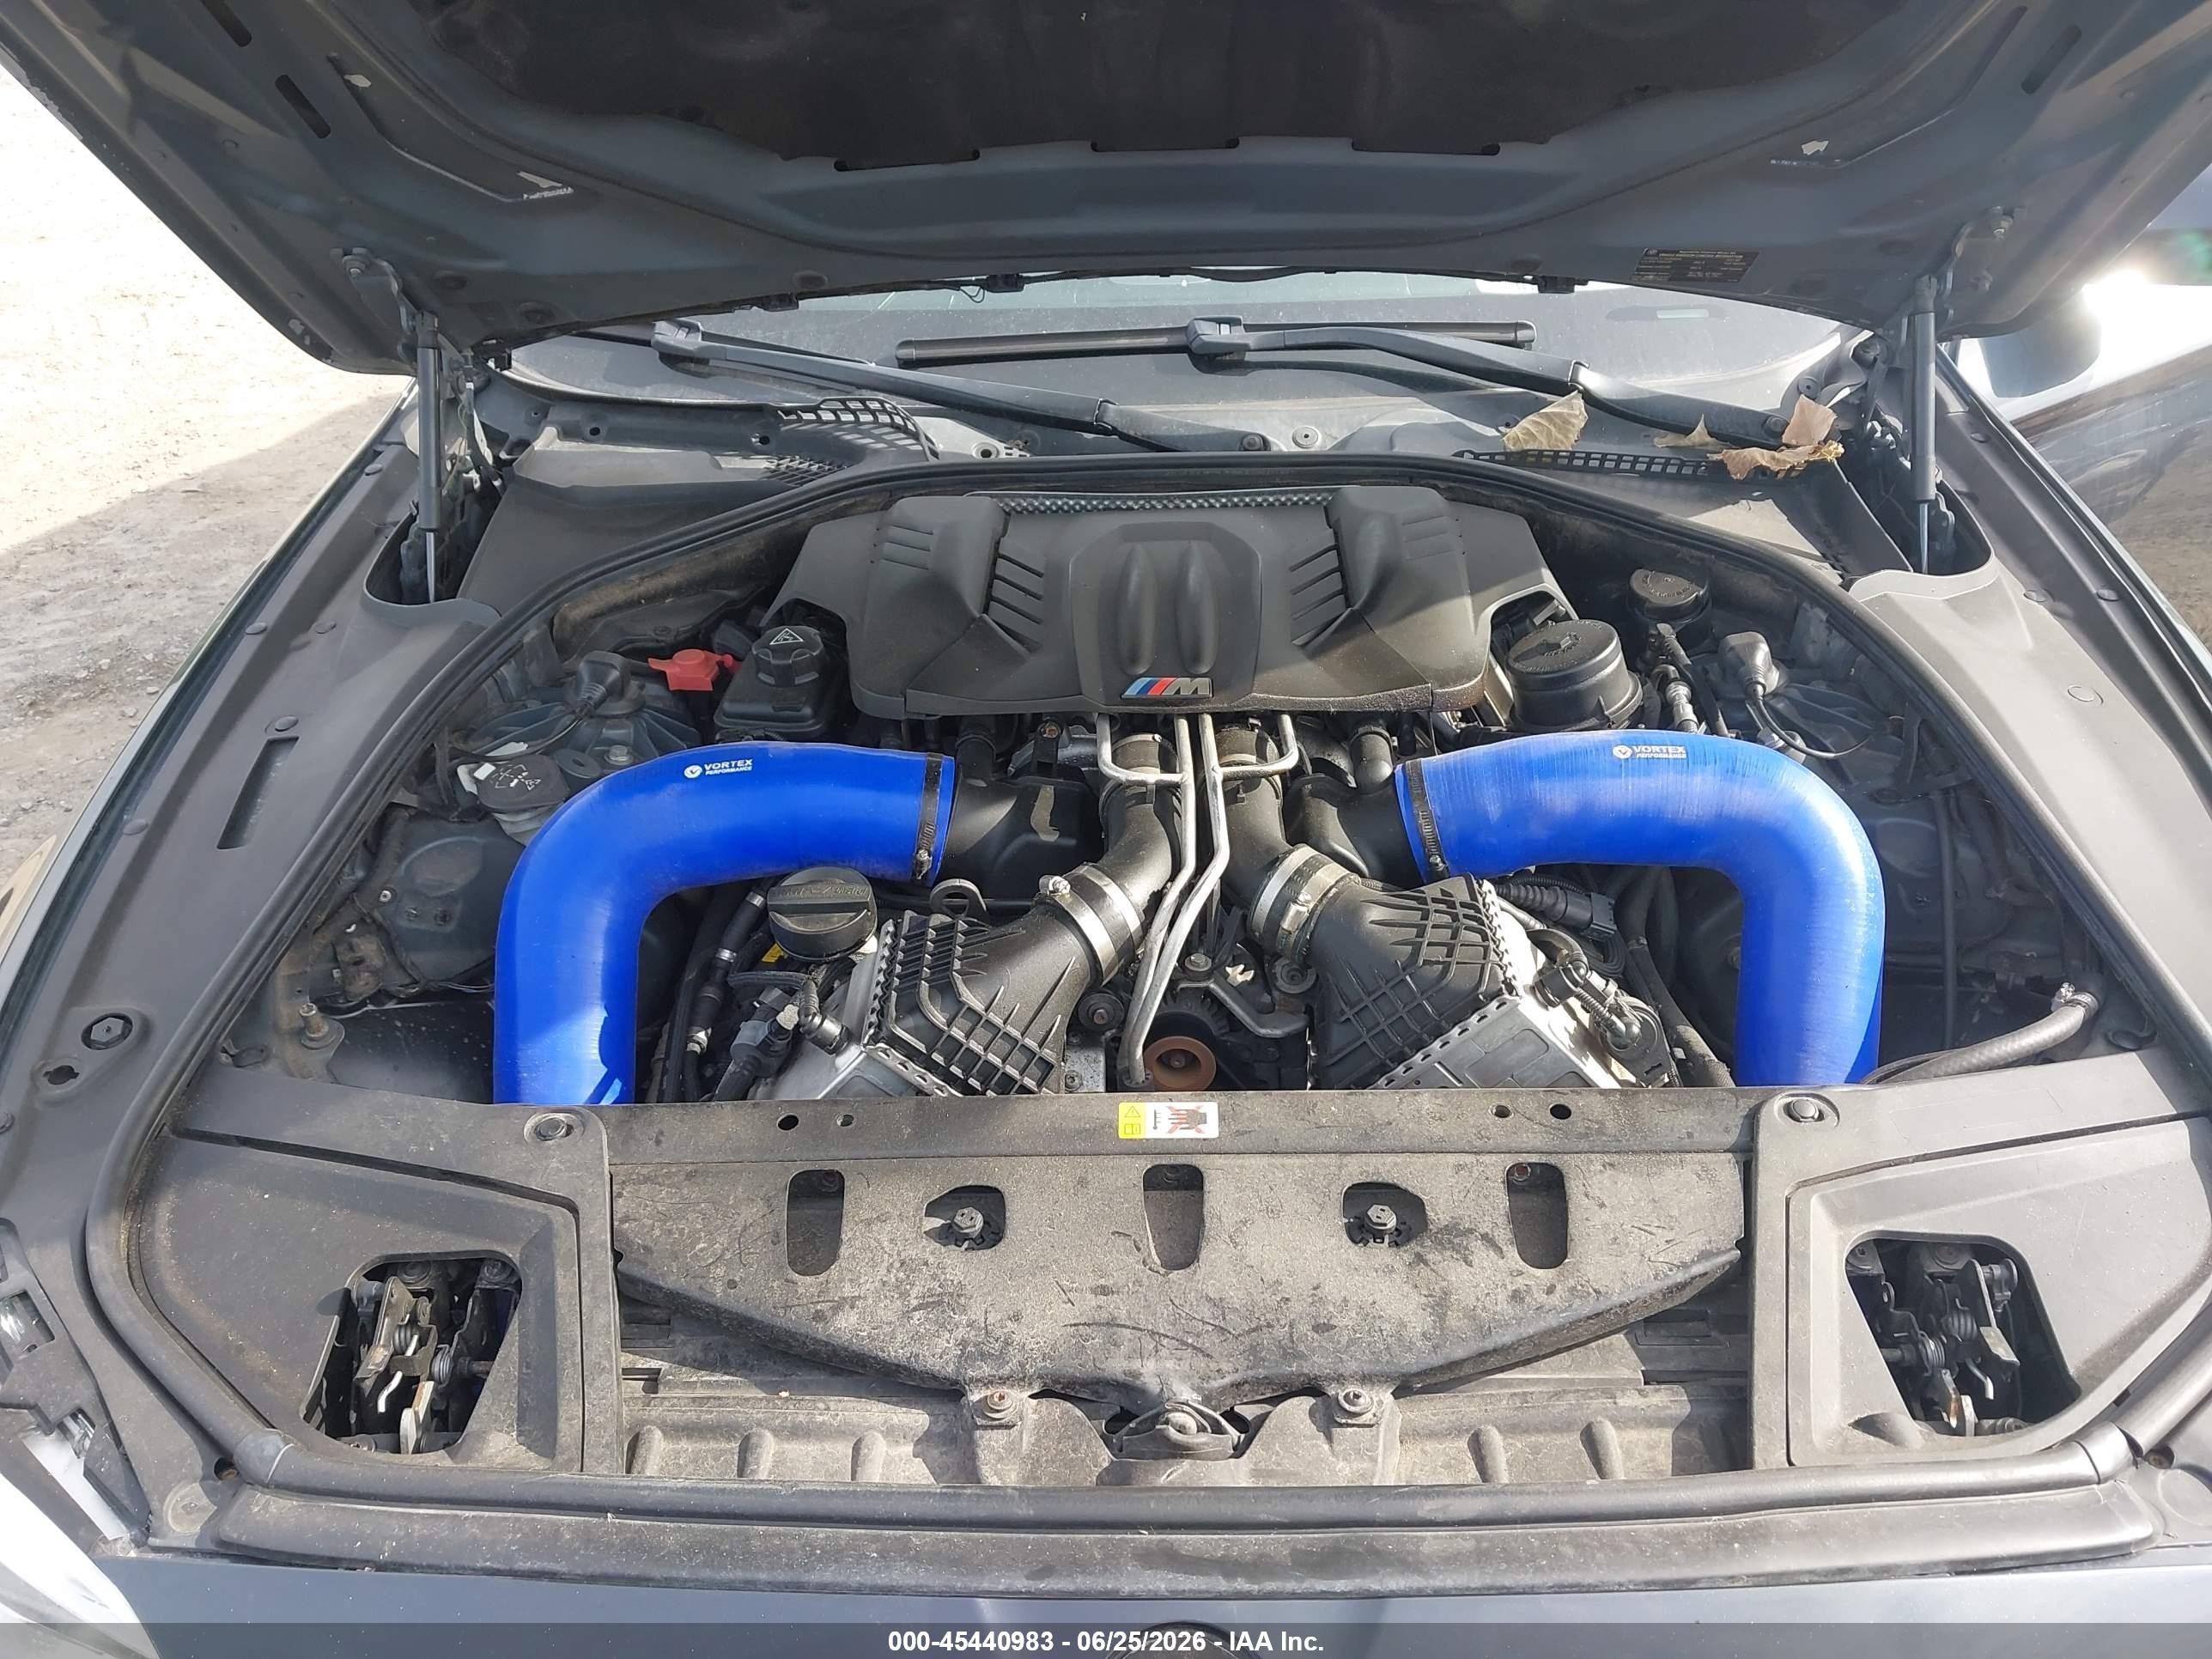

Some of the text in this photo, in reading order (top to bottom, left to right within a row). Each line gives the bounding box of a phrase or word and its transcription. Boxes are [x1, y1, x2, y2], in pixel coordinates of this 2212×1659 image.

[1632, 744, 1686, 754] VORTEX
[704, 758, 753, 770] VORTEX
[705, 765, 752, 775] PERFORMANCE
